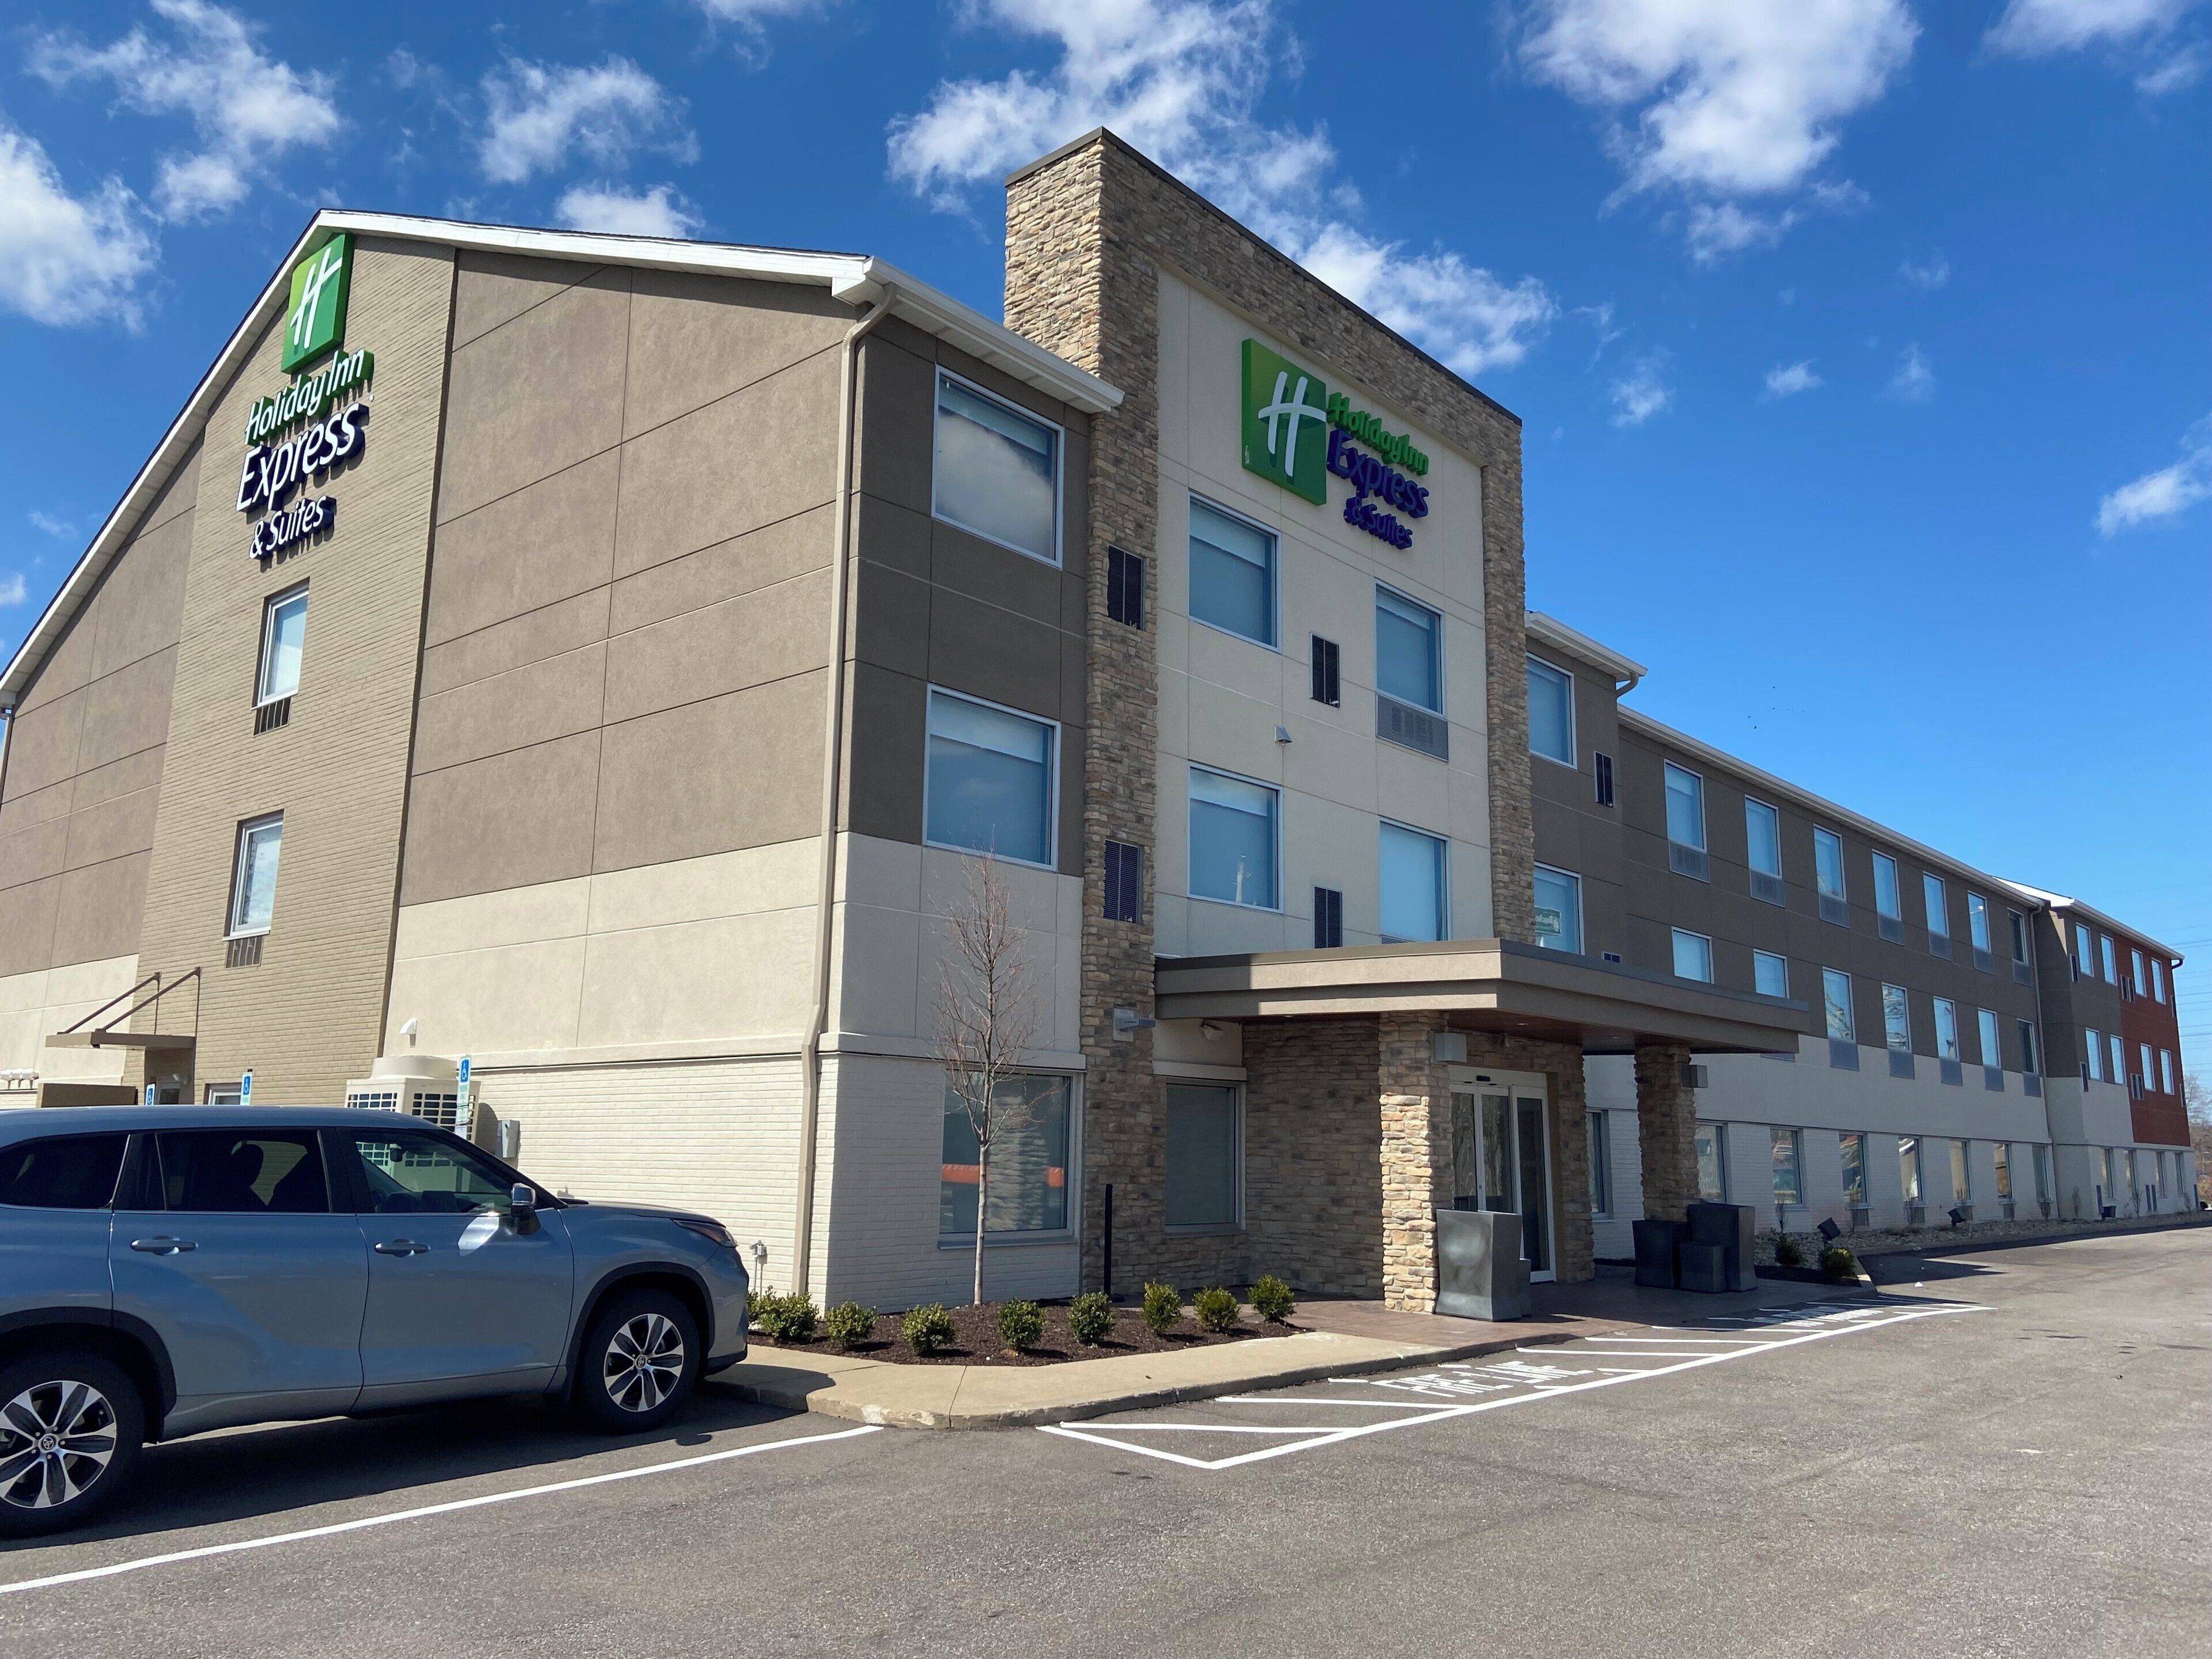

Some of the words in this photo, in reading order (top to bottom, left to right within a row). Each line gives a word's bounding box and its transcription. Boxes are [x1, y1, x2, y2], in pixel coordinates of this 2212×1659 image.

[245, 372, 329, 445] Holiday
[326, 349, 369, 396] Inn
[1327, 392, 1402, 464] Holiday
[1399, 434, 1429, 476] Inn
[236, 403, 364, 511] Express
[1327, 428, 1429, 518] Express
[249, 520, 263, 559] &
[266, 496, 331, 551] Suites
[1343, 497, 1363, 525] &
[1358, 504, 1412, 550] Suites
[1369, 1373, 1514, 1398] FIRE
